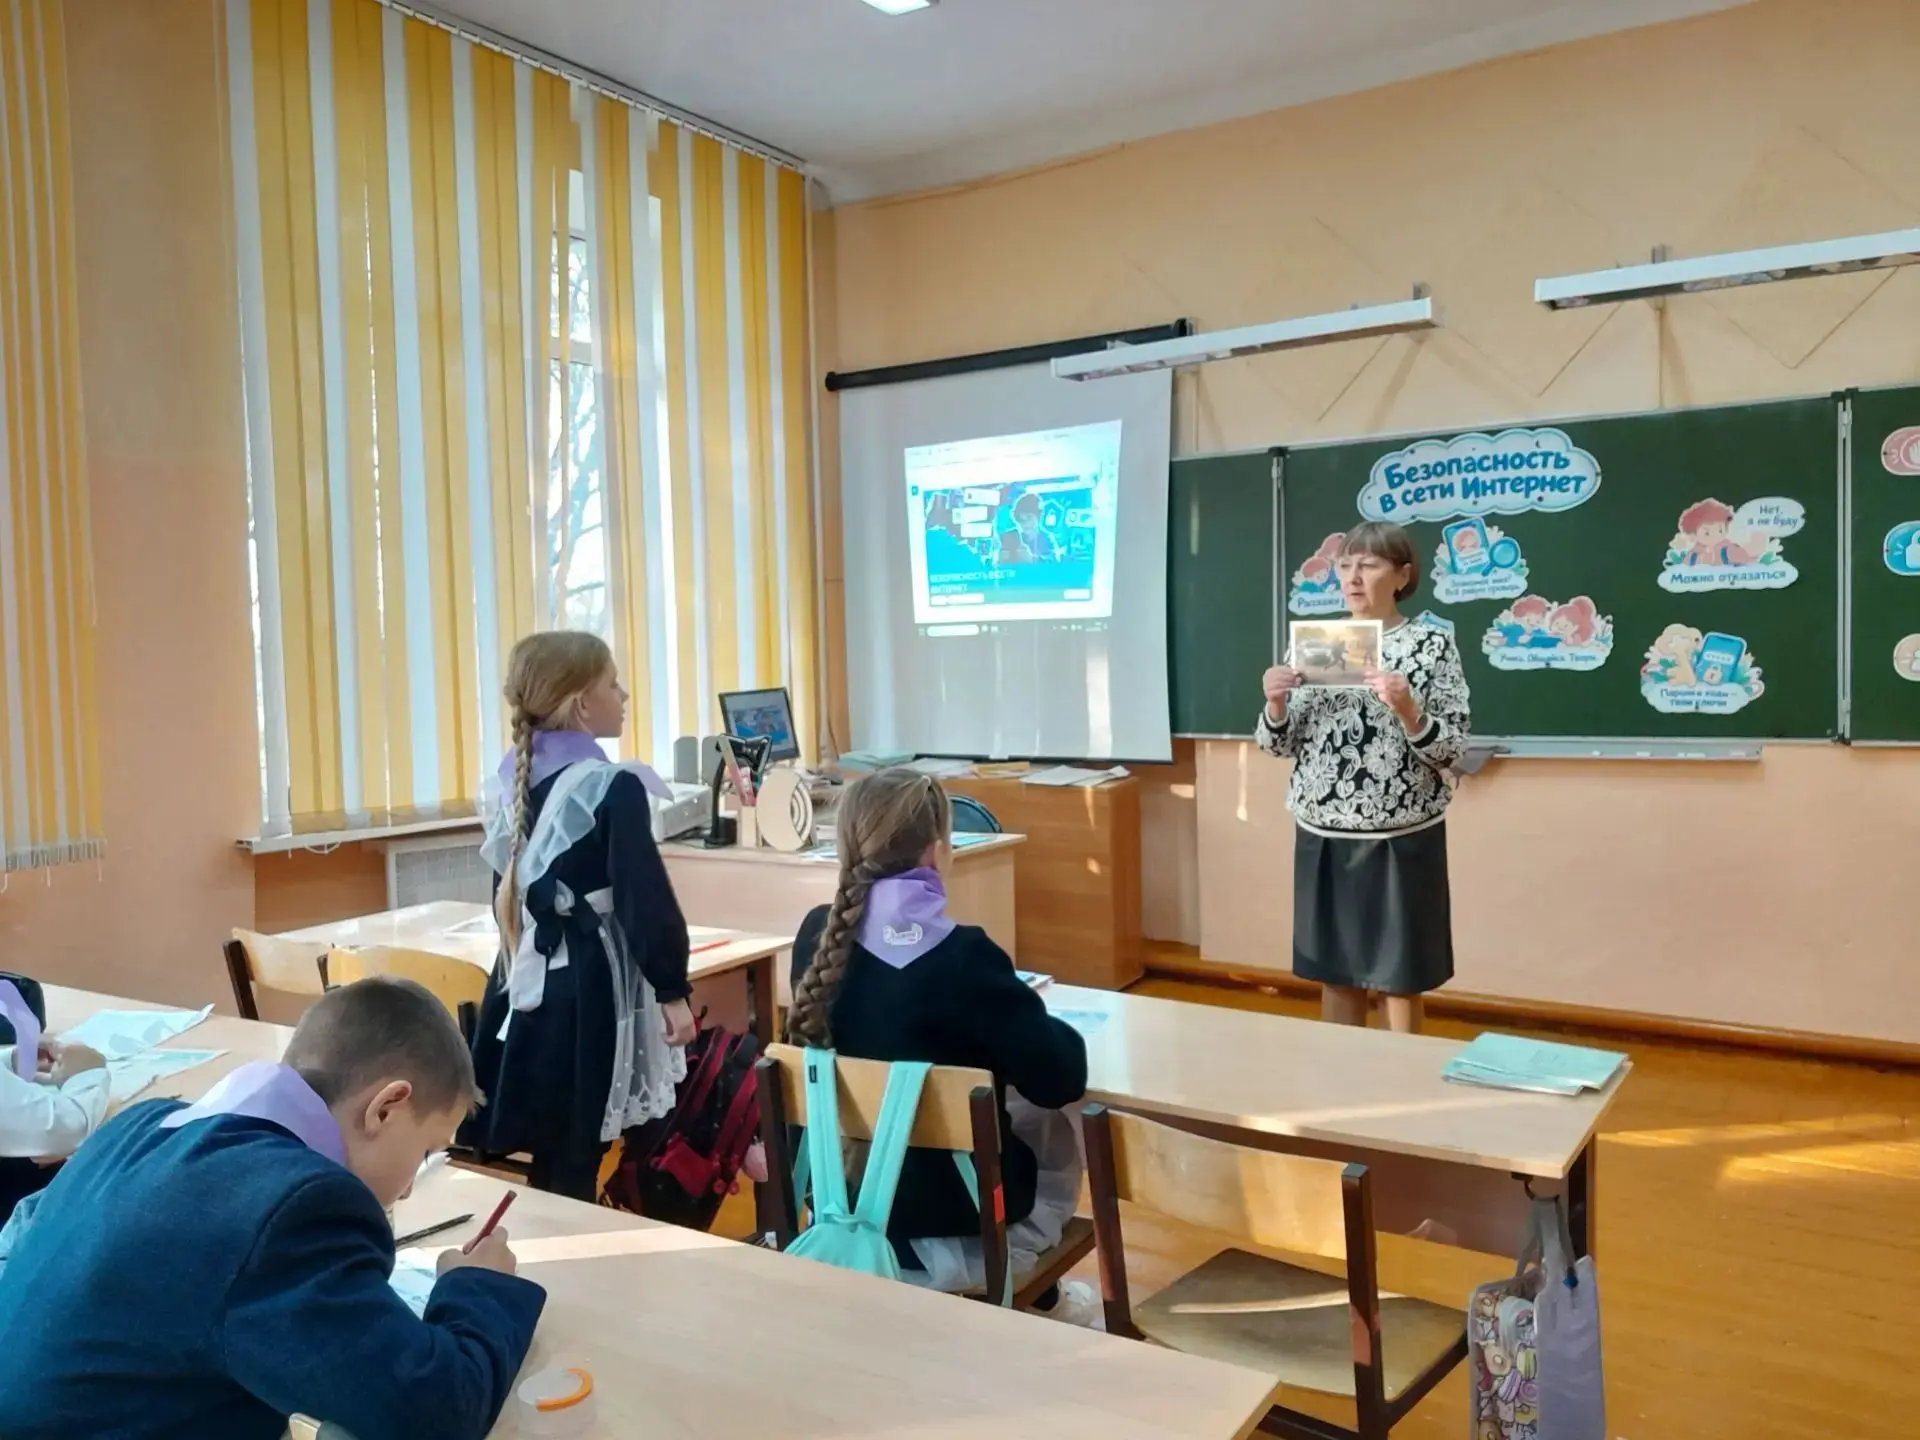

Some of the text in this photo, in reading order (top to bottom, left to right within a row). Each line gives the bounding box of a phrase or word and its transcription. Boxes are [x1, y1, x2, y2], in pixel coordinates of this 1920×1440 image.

[1384, 451, 1570, 489] Безопасность
[1401, 482, 1455, 506] сети
[1461, 475, 1587, 499] Интернет
[1670, 572, 1786, 584] Можно отказаться
